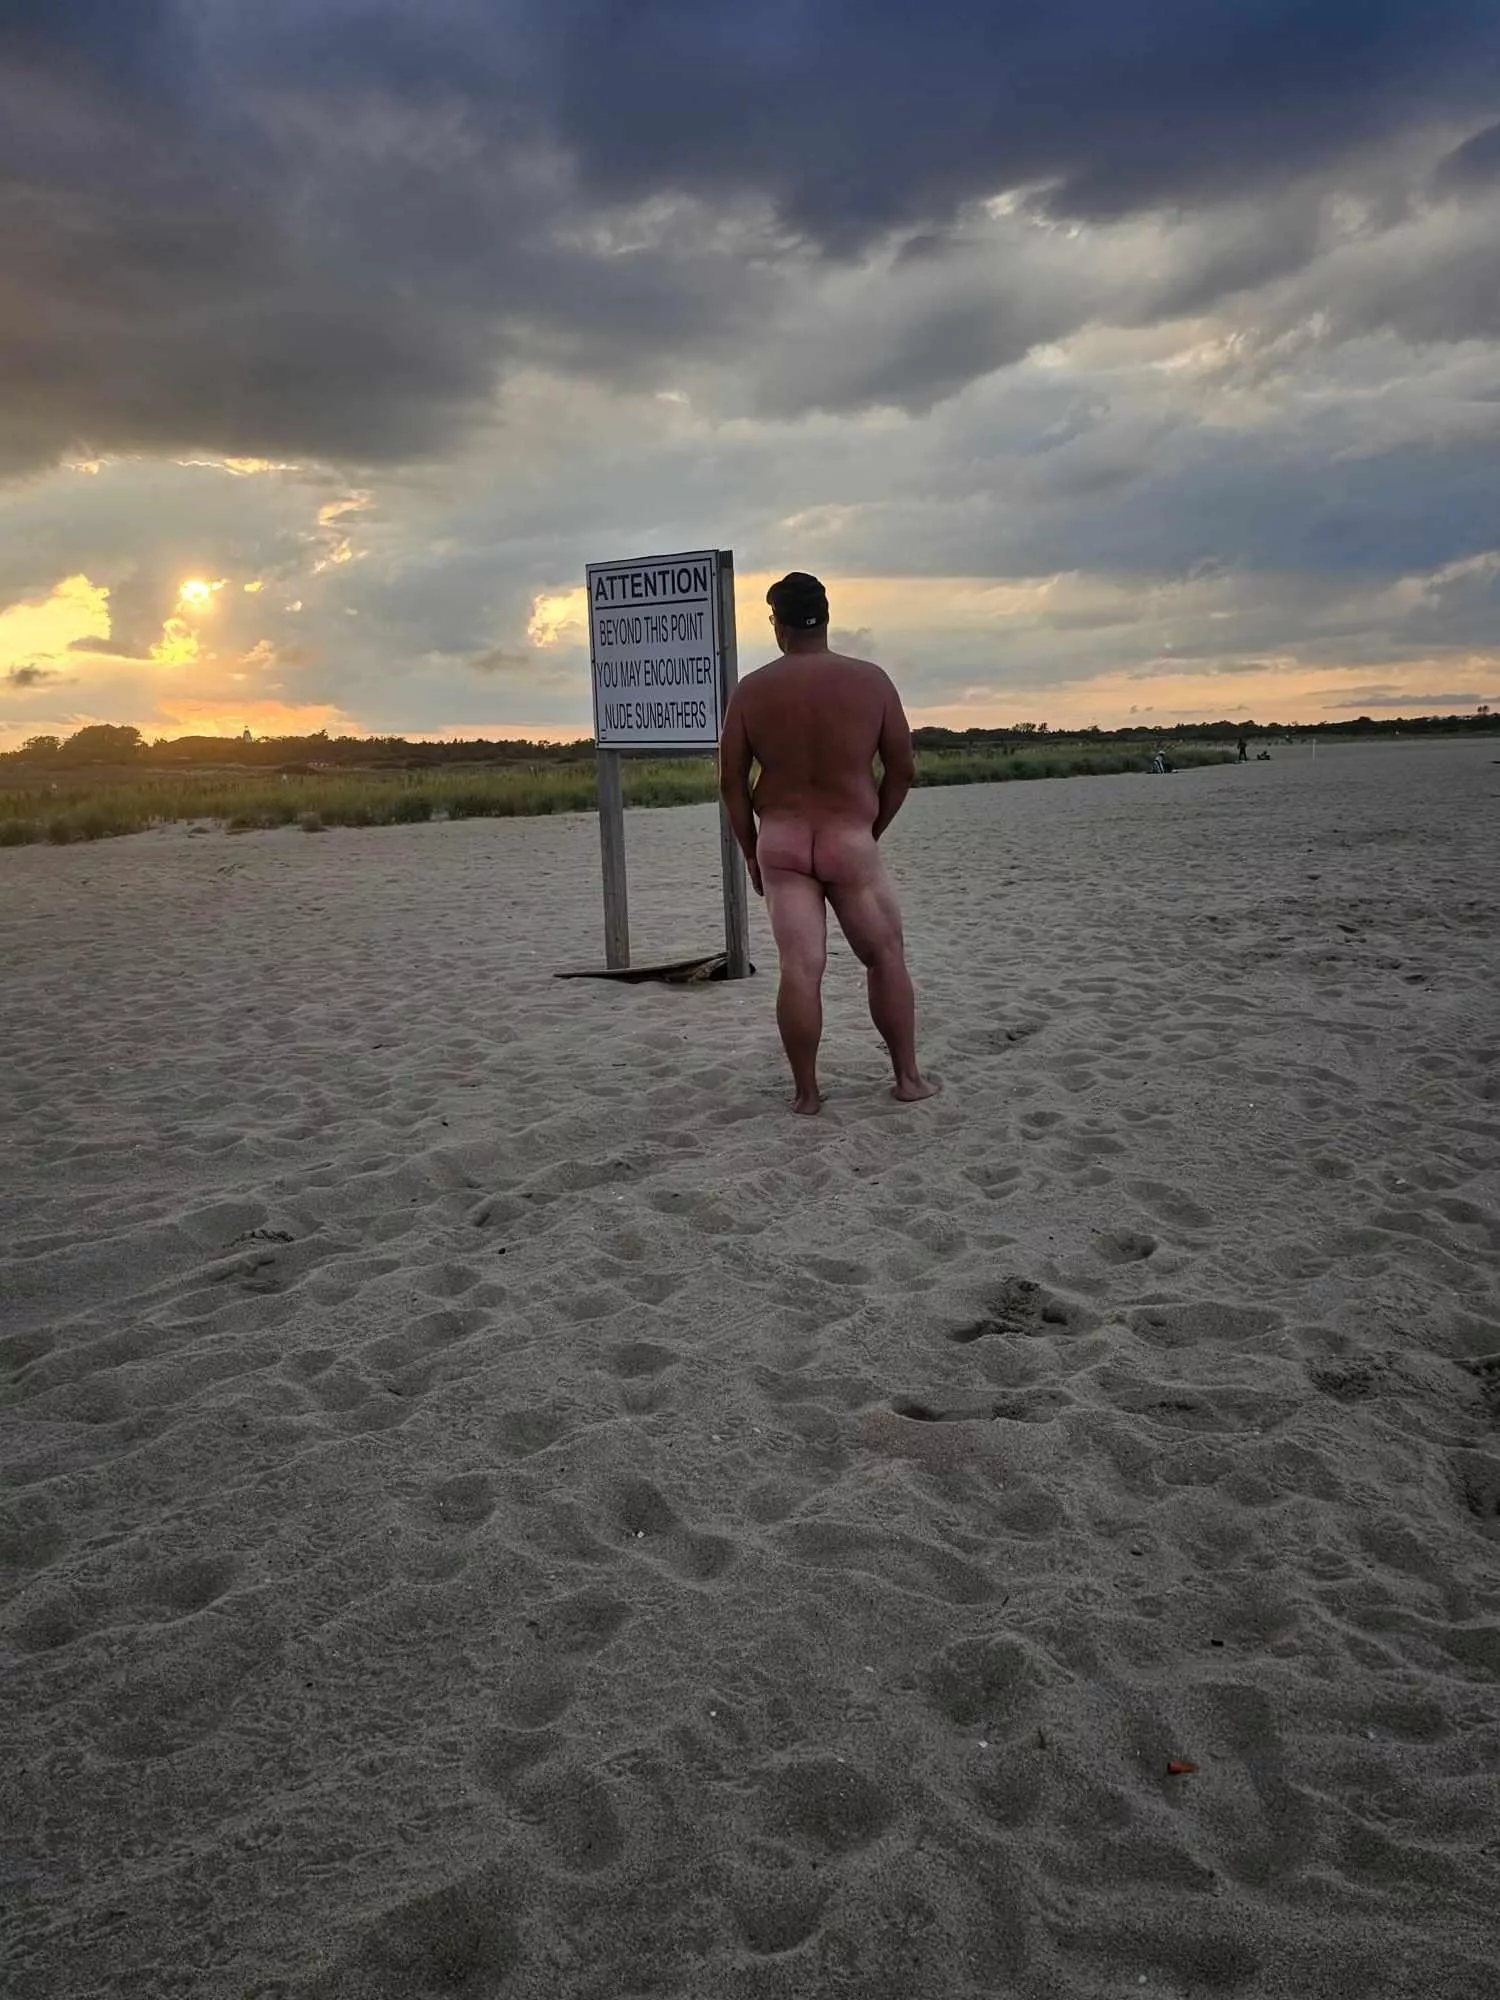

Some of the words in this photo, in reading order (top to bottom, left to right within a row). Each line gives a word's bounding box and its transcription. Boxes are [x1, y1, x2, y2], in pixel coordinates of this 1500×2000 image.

[595, 566, 708, 602] ATTENTION
[599, 616, 642, 646] BEYOND
[644, 613, 669, 644] THIS
[671, 612, 704, 642] POINT
[596, 661, 618, 688] YOU
[621, 660, 643, 688] MAY
[644, 656, 712, 687] ENCOUNTER
[605, 702, 632, 730] NUDE
[635, 700, 706, 729] SUNBATHERS
